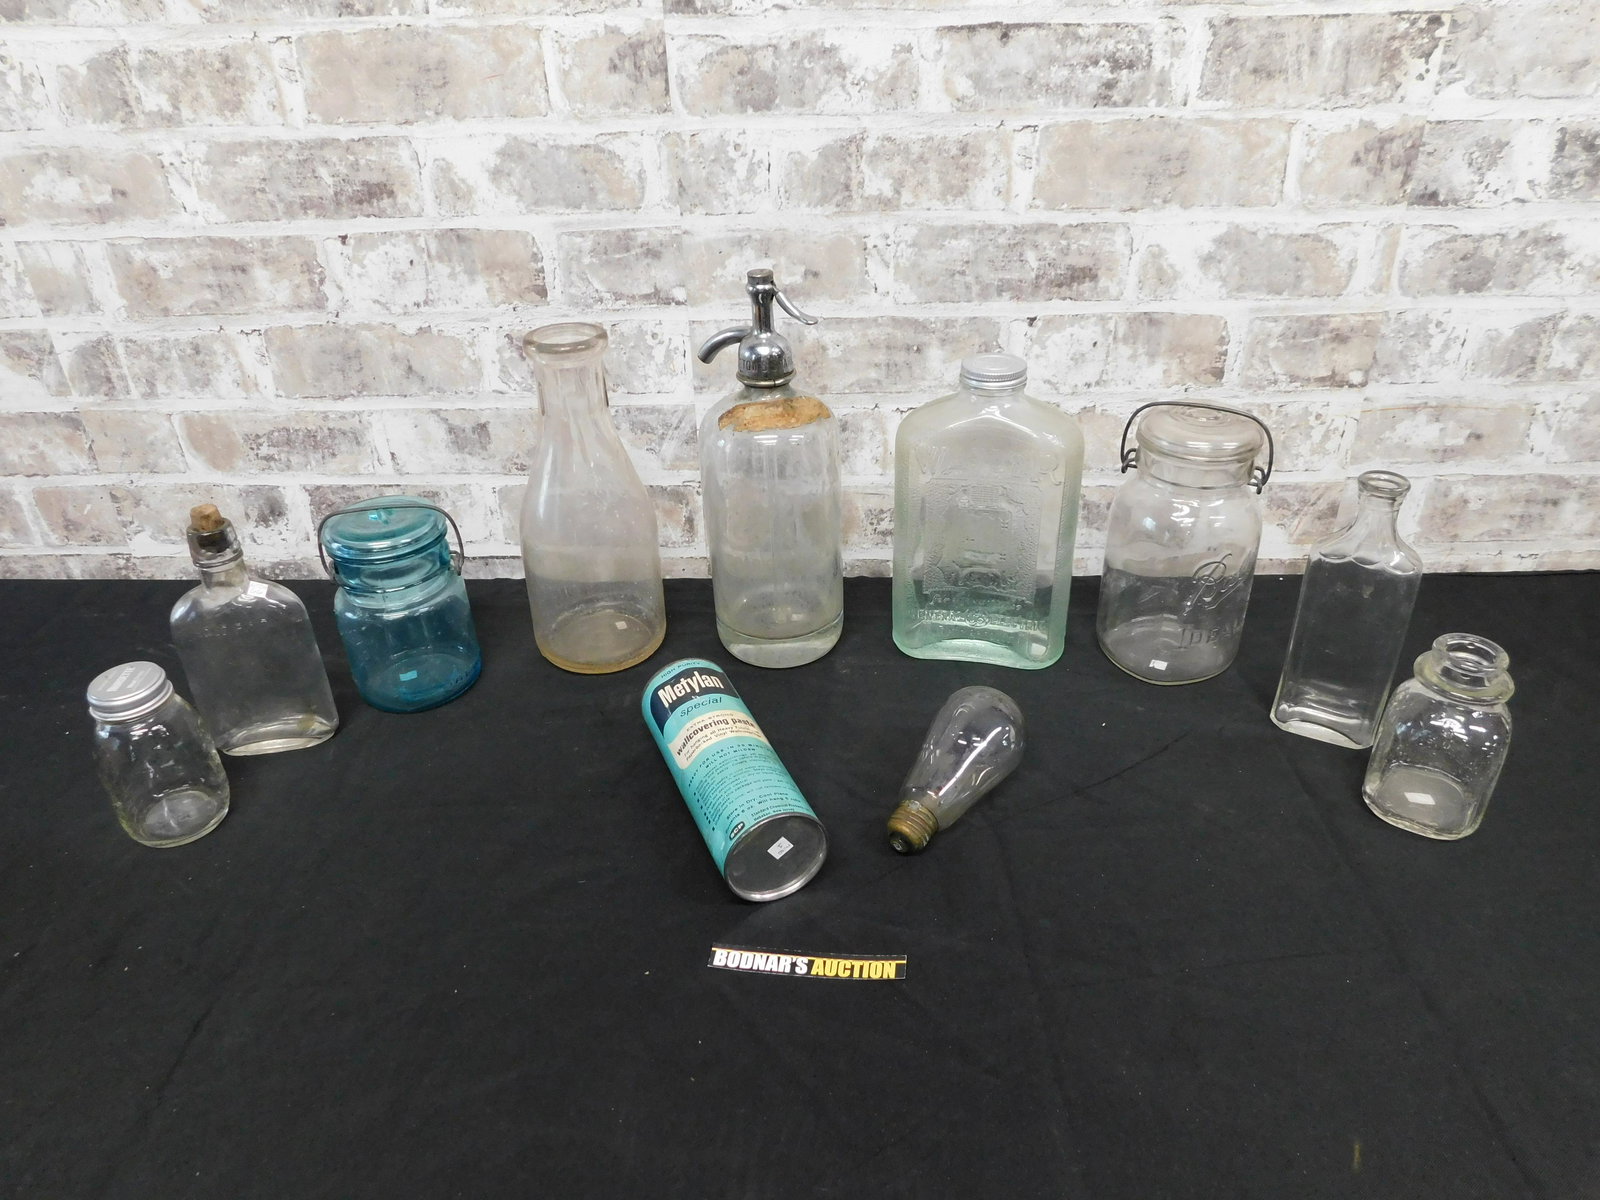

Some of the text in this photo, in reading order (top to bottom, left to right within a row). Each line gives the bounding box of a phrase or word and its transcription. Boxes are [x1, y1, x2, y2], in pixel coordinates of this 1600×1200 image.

[657, 670, 724, 708] Metylan
[681, 697, 722, 716] special
[676, 718, 730, 756] wallcovering
[713, 949, 897, 979] BODNAR'S AUCTION
